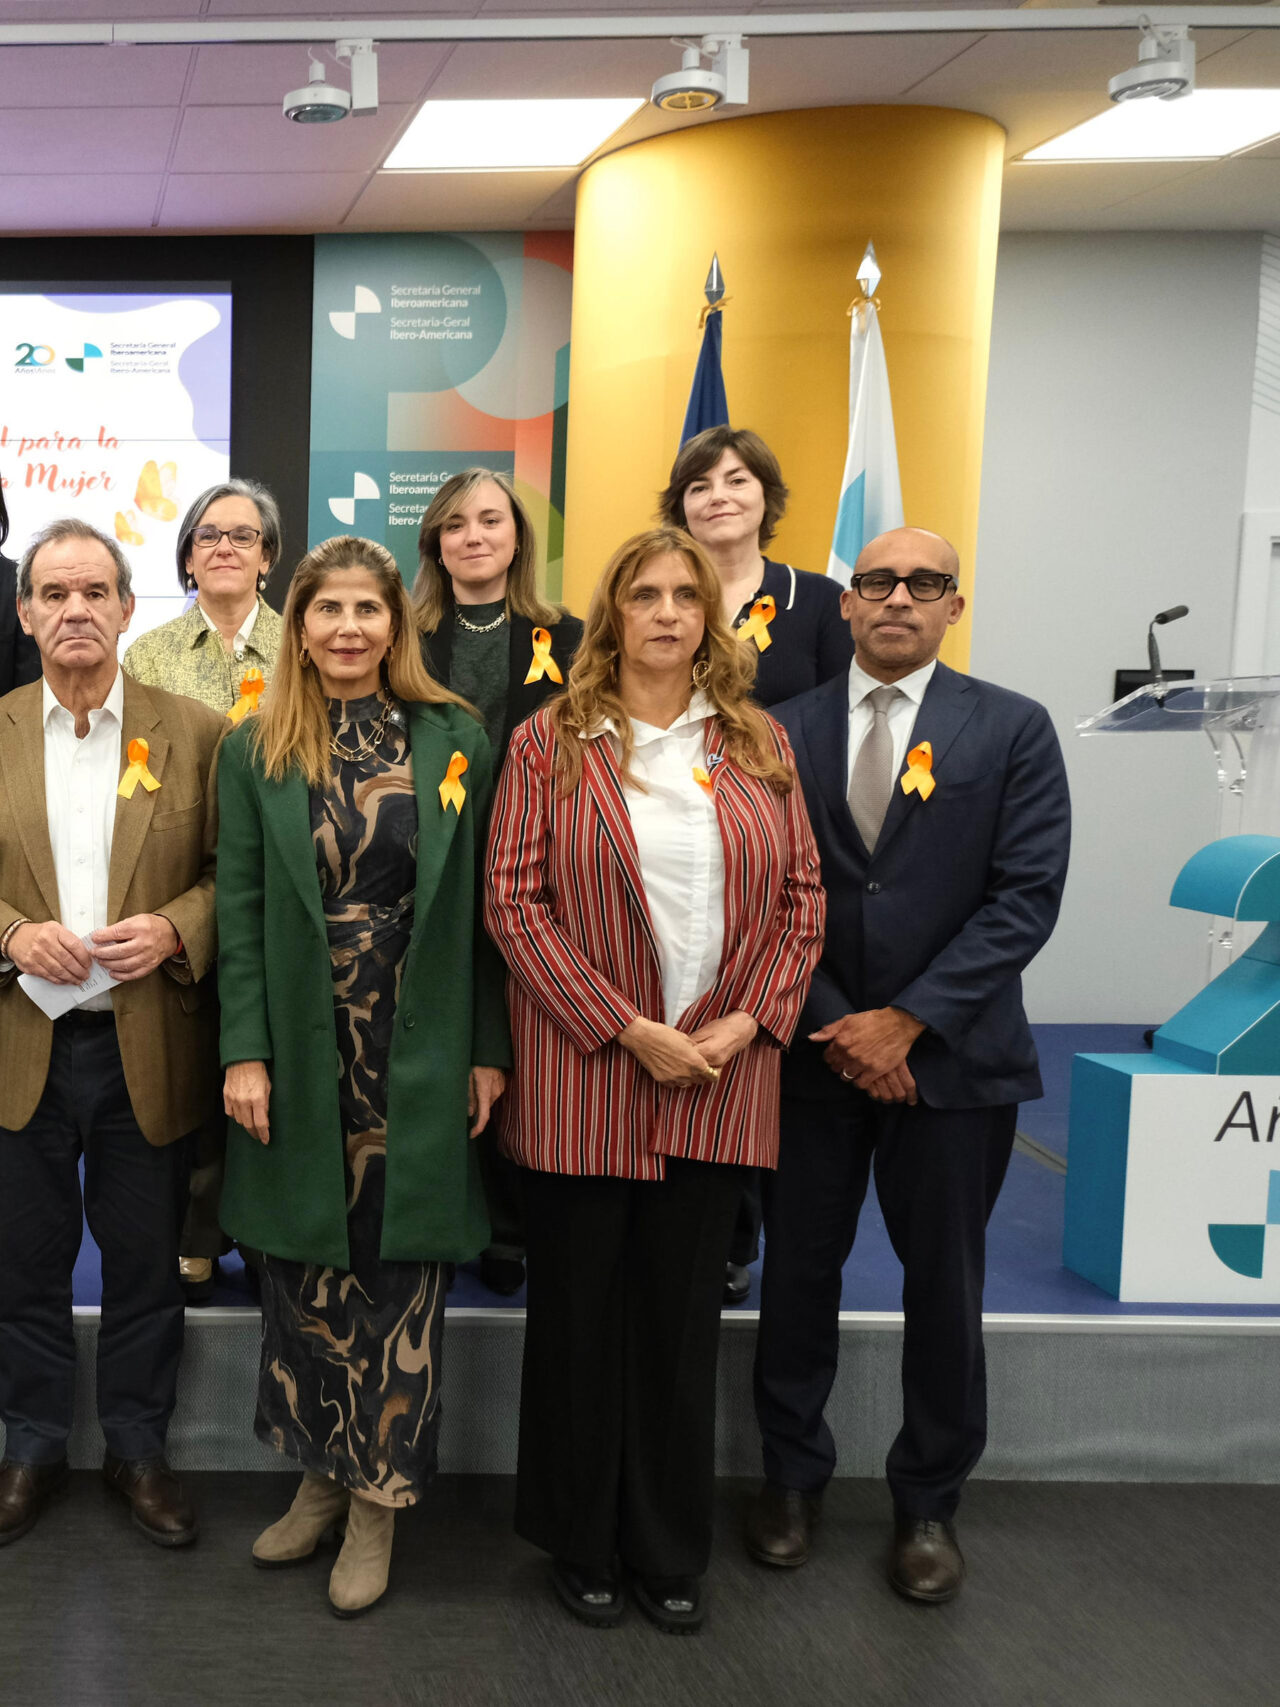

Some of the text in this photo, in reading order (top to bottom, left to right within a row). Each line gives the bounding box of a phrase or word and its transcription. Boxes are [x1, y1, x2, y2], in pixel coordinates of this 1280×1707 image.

[442, 284, 481, 296] General
[391, 298, 468, 308] Iberoamericana
[390, 317, 470, 328] Secretaria-Geral
[390, 330, 473, 340] Ibero-Americana
[17, 431, 84, 457] para
[98, 425, 121, 449] la
[25, 463, 115, 498] Mujer
[389, 472, 438, 482] Secretaría
